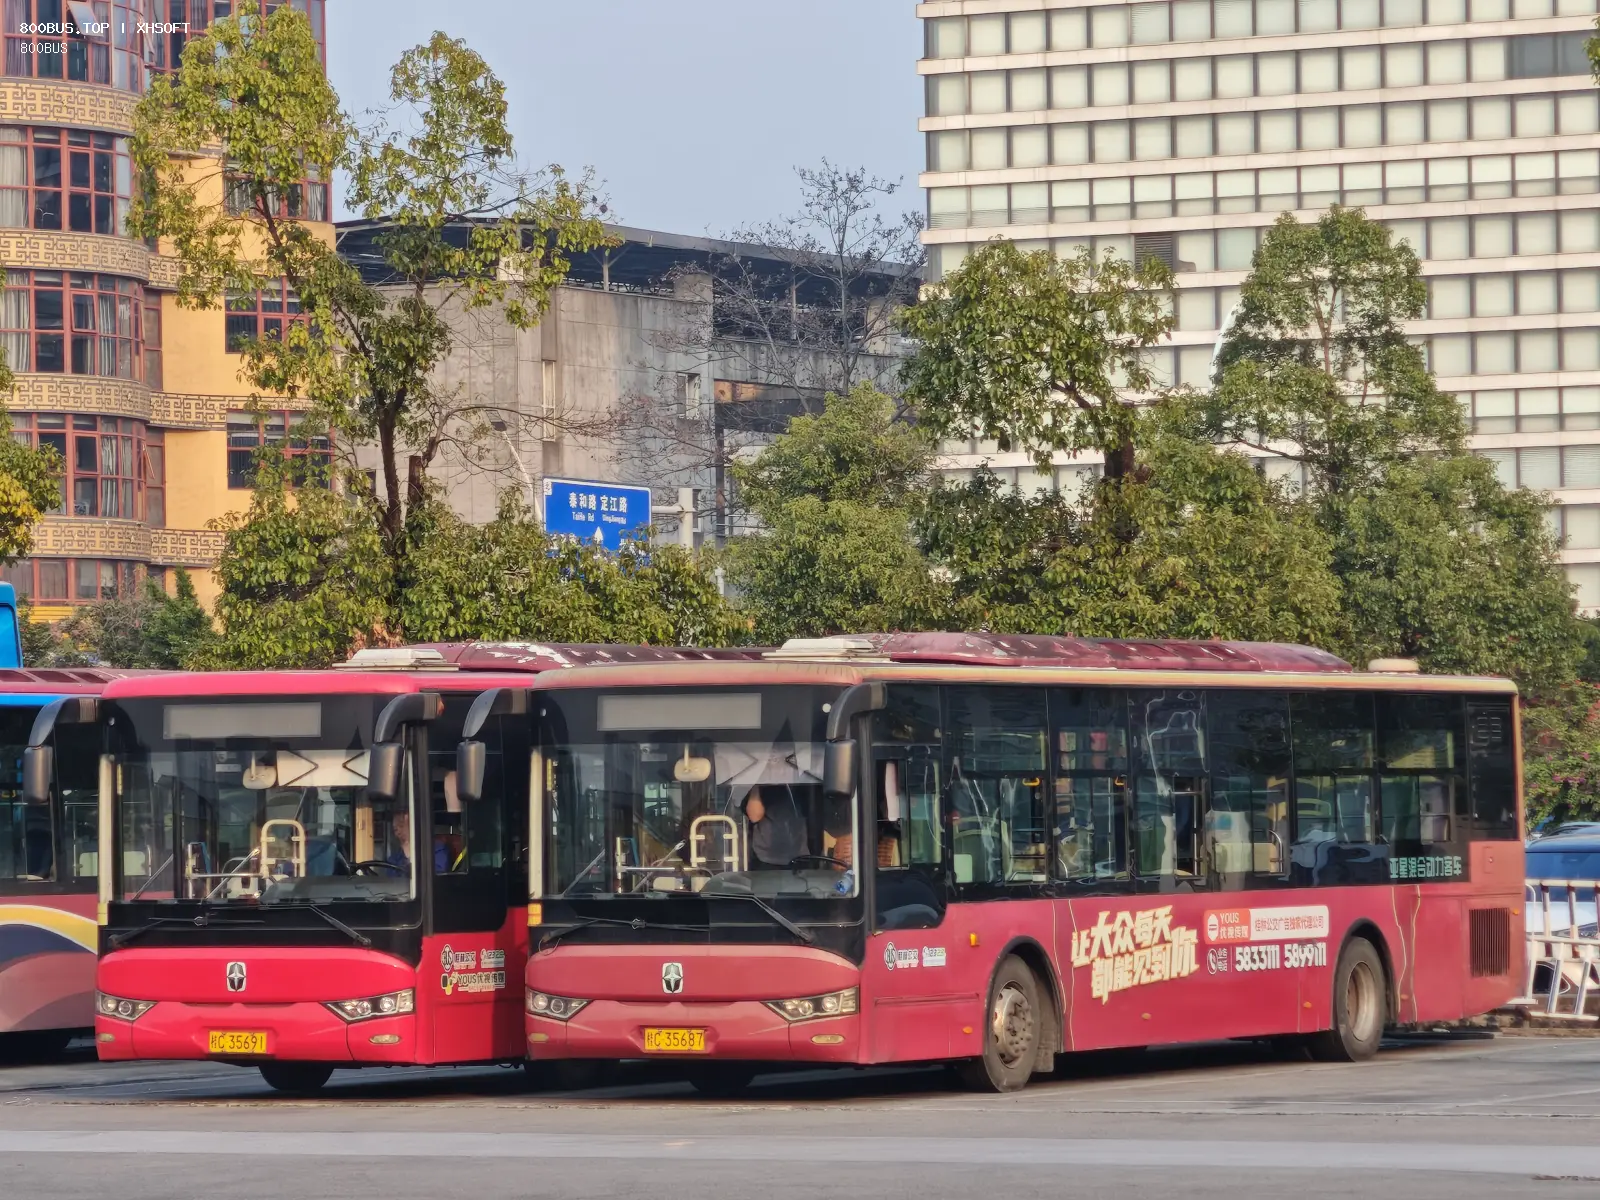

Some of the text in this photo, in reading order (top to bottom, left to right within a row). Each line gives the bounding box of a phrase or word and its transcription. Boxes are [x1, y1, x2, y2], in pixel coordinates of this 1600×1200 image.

[569, 492, 627, 513] 泰和路 定江路
[1220, 912, 1240, 924] YOUS
[1070, 904, 1174, 969] 让大众每天
[1091, 926, 1200, 1005] 都能见到你
[1235, 944, 1280, 972] 5833111
